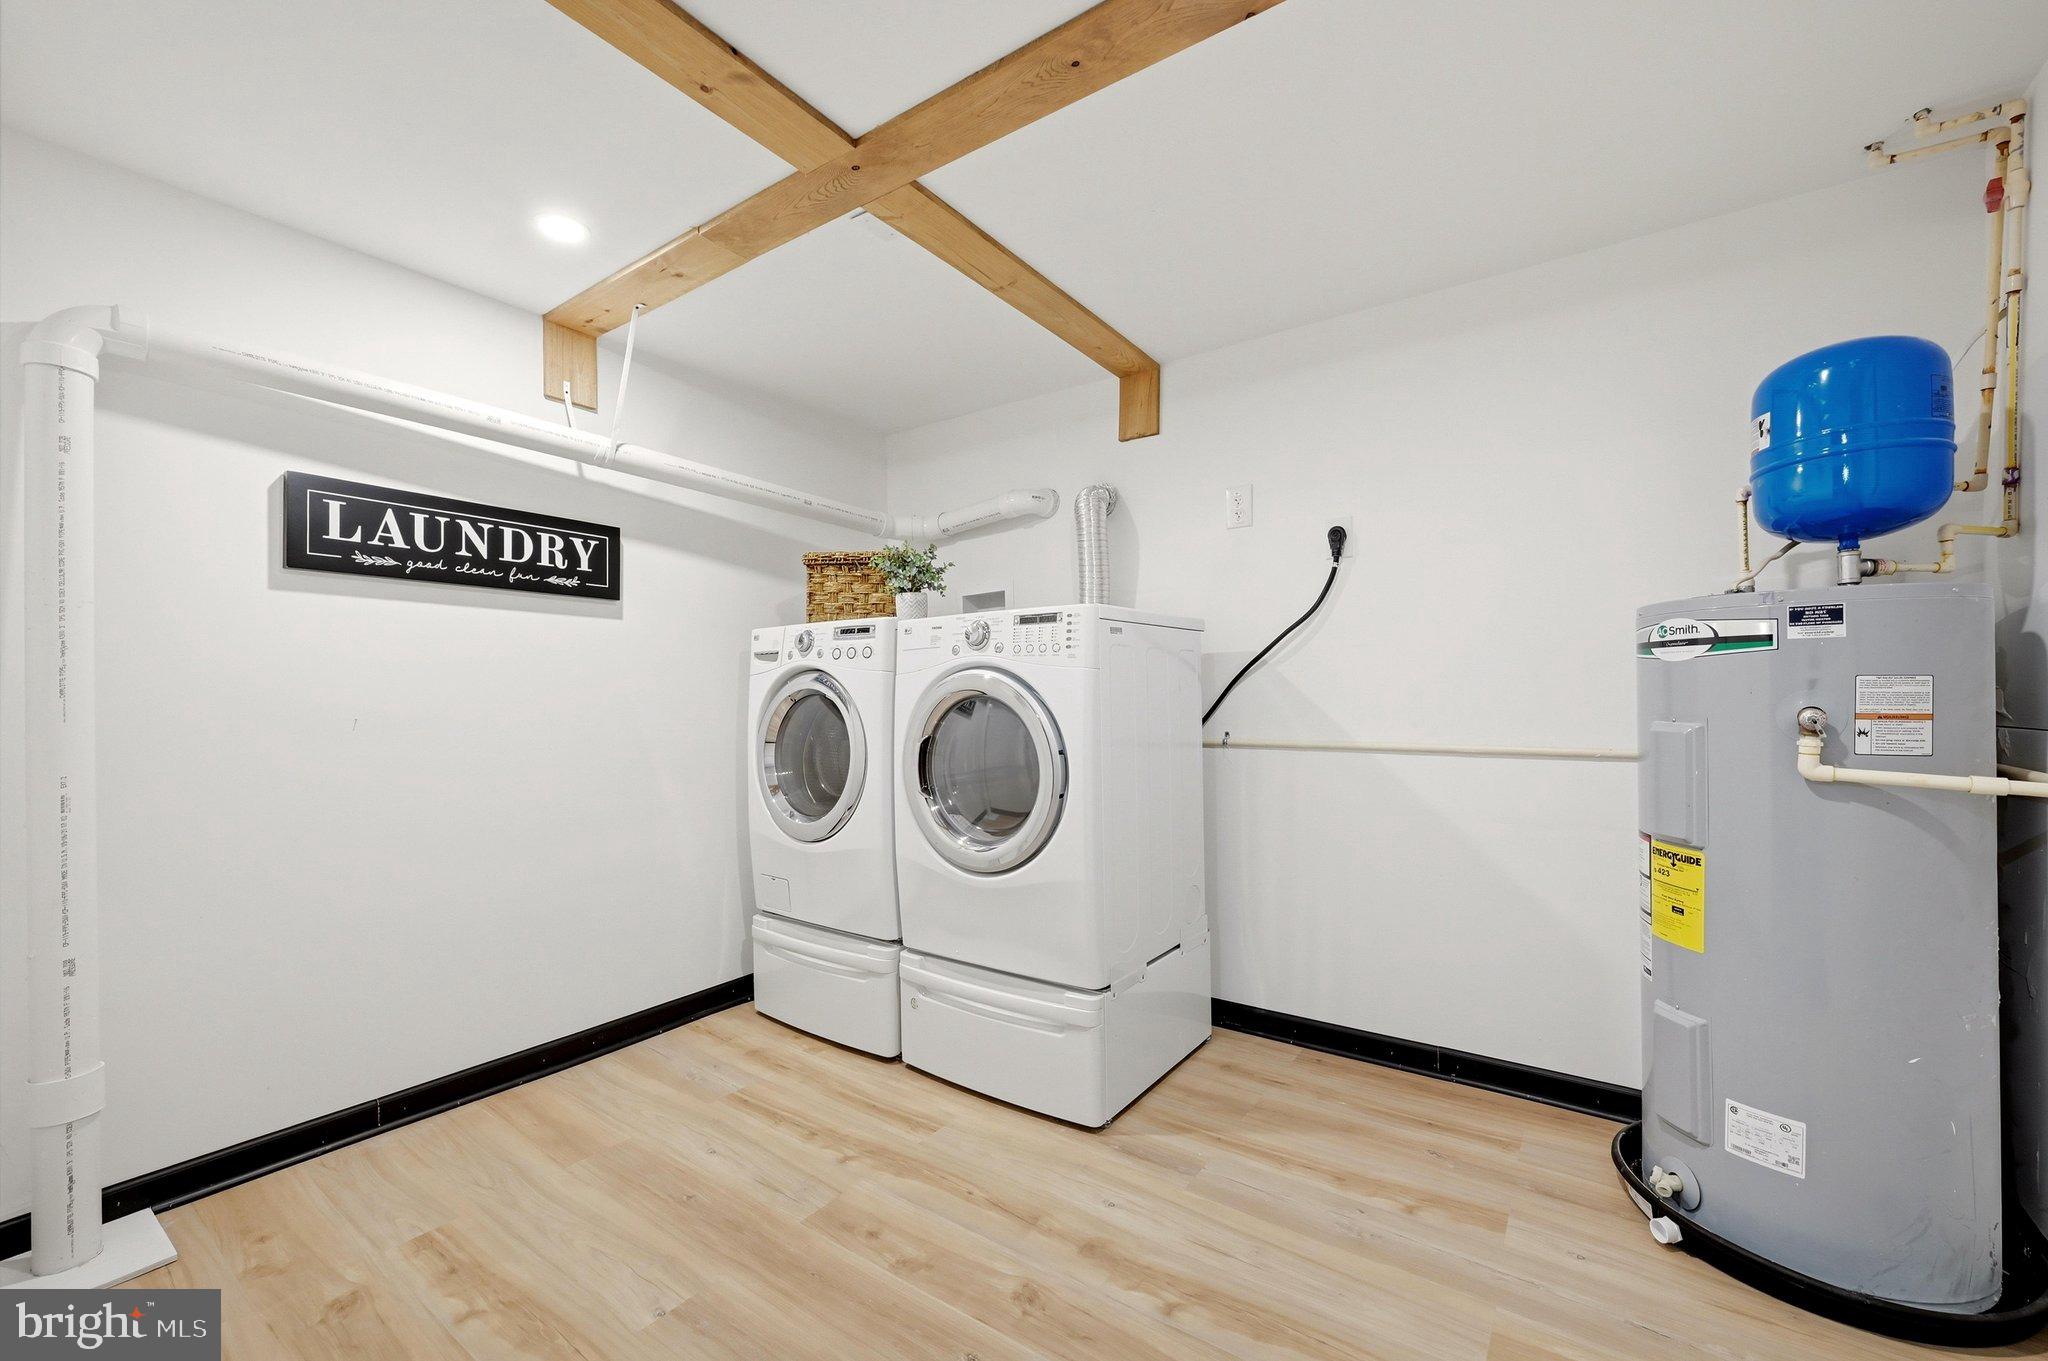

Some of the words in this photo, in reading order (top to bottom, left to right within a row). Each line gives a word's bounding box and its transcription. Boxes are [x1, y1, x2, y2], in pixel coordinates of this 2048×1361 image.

[322, 498, 599, 572] LAUNDRY
[405, 558, 447, 574] good
[455, 561, 503, 578] clean
[509, 566, 540, 584] fun
[1668, 624, 1699, 636] Smith
